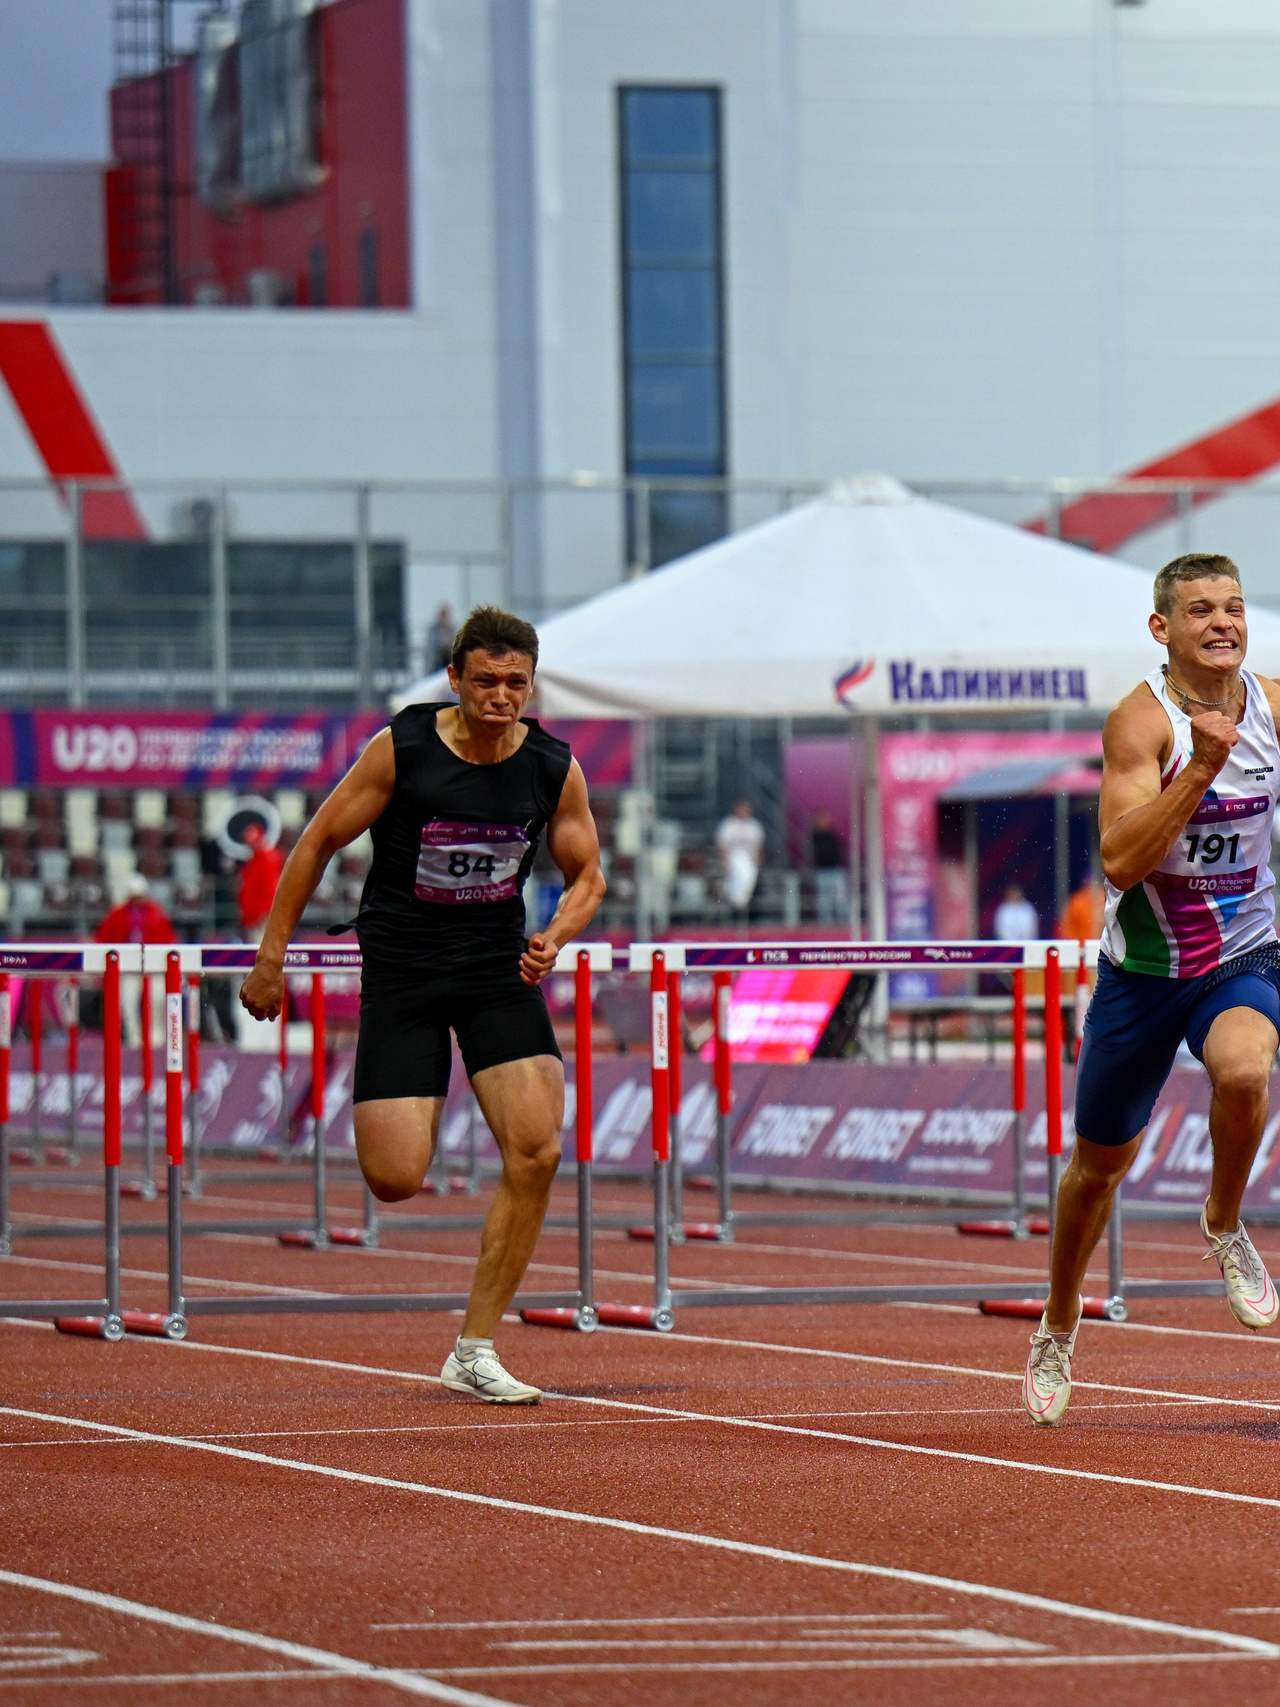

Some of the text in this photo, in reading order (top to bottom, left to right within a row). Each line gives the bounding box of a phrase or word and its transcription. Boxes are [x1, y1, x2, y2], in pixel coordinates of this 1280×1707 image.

[52, 725, 138, 771] U20
[1185, 833, 1240, 864] 191
[448, 852, 496, 878] 84
[1188, 878, 1217, 891] U20
[1218, 877, 1254, 886] ПЕРВЕНСТВО
[456, 889, 482, 901] U20
[284, 952, 363, 965] ПСБ ПЕРВЕН
[762, 950, 789, 961] ПСБ
[799, 950, 867, 961] ПЕРВЕНСТВО
[868, 949, 912, 961] РОССИИ
